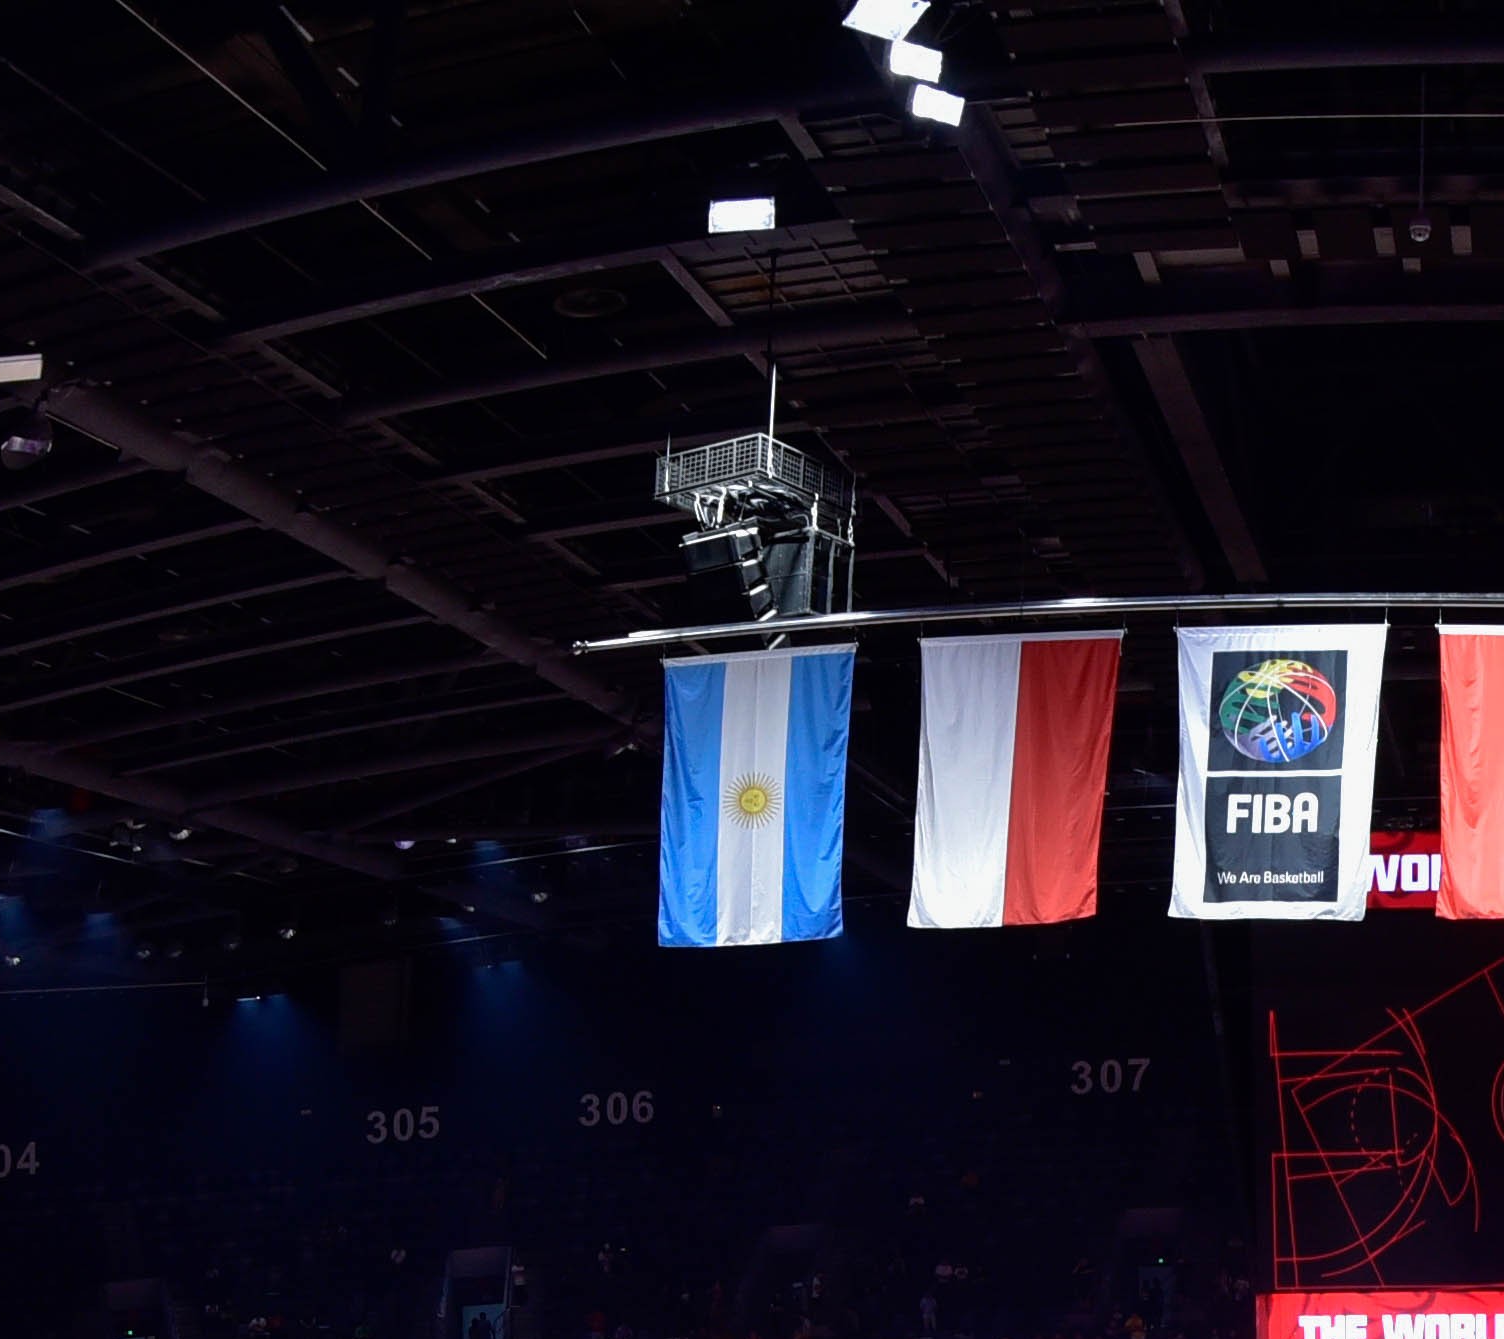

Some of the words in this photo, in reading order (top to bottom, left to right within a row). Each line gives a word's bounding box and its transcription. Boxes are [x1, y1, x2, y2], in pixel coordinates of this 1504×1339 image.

[1226, 792, 1319, 834] FIBA
[1217, 871, 1236, 885] We
[1239, 871, 1261, 884] Are
[1263, 870, 1324, 884] Basketball
[1071, 1058, 1150, 1094] 307
[366, 1106, 439, 1144] 305
[579, 1091, 653, 1126] 306
